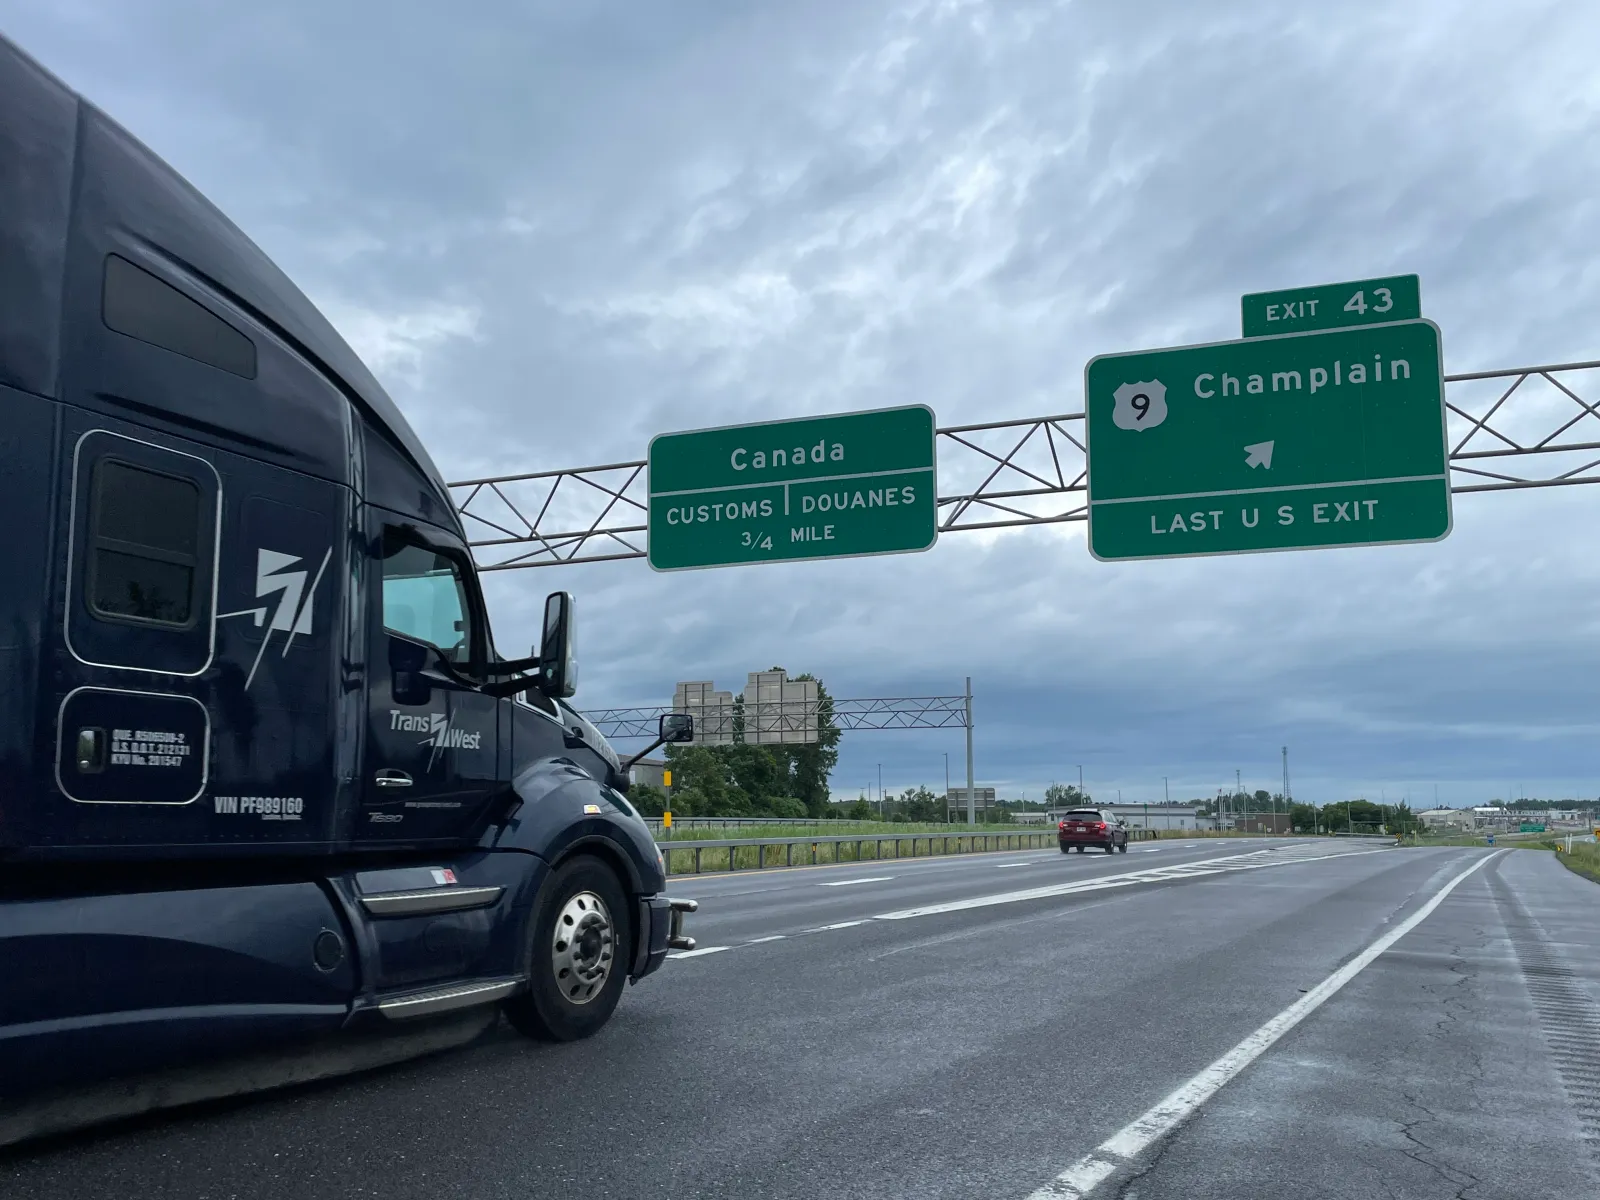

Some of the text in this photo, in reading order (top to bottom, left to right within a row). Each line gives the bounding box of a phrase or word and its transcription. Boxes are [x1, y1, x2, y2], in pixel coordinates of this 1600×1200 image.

[1266, 287, 1394, 321] EXIT 43
[1194, 354, 1411, 399] Champlain
[1131, 393, 1151, 421] 9
[730, 440, 844, 470] Canada
[666, 500, 773, 525] CUSTOMS
[802, 487, 916, 514] DOUANES
[1151, 500, 1379, 534] LAST U S EXIT
[791, 525, 835, 543] MILE
[390, 709, 481, 749] Trans West
[214, 796, 303, 814] VIN PF989160
